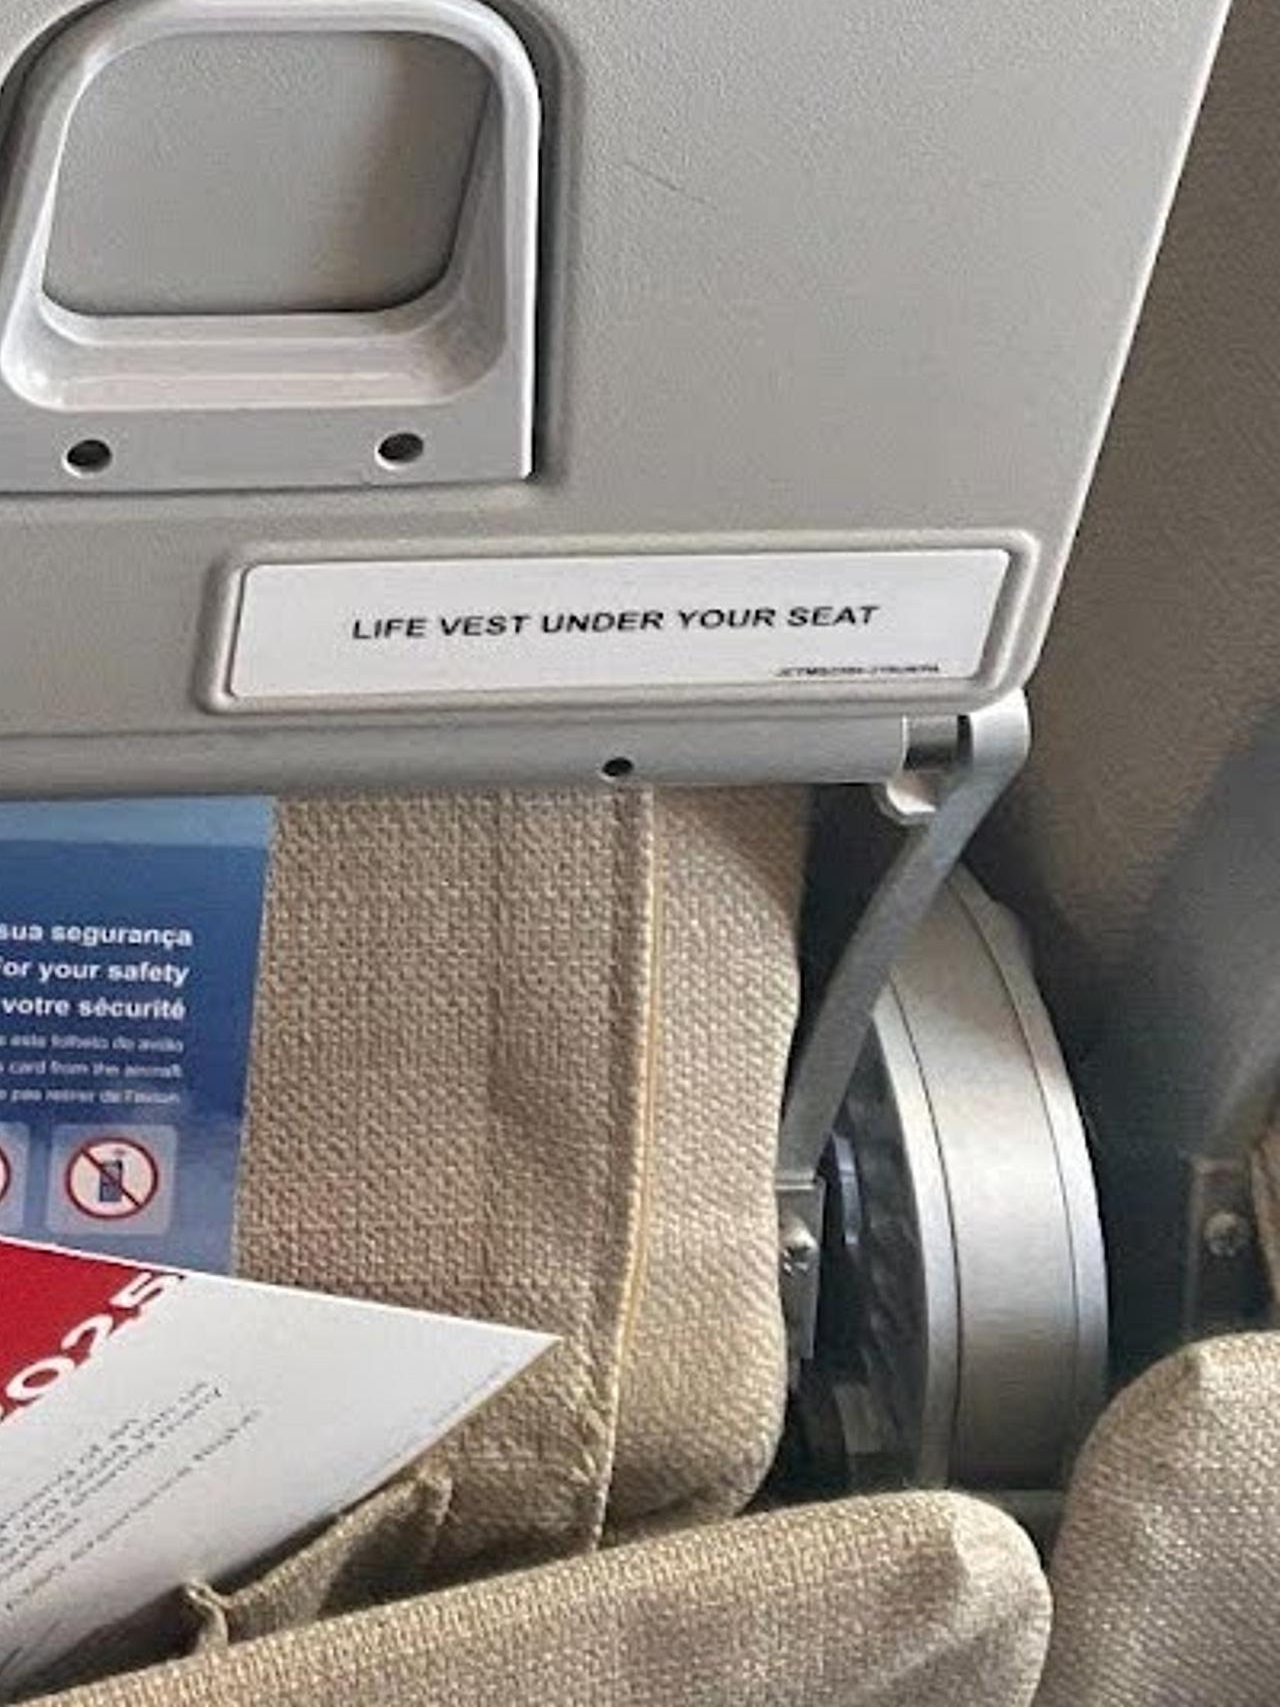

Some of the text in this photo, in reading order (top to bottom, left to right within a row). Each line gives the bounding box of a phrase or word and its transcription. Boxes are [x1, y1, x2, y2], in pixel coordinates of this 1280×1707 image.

[352, 605, 881, 640] LIFE VEST UNDER YOUR SEAT
[50, 924, 194, 950] segurança
[38, 963, 100, 983] your
[107, 961, 190, 988] safety
[1, 995, 72, 1017] votre
[78, 996, 186, 1020] sécurité
